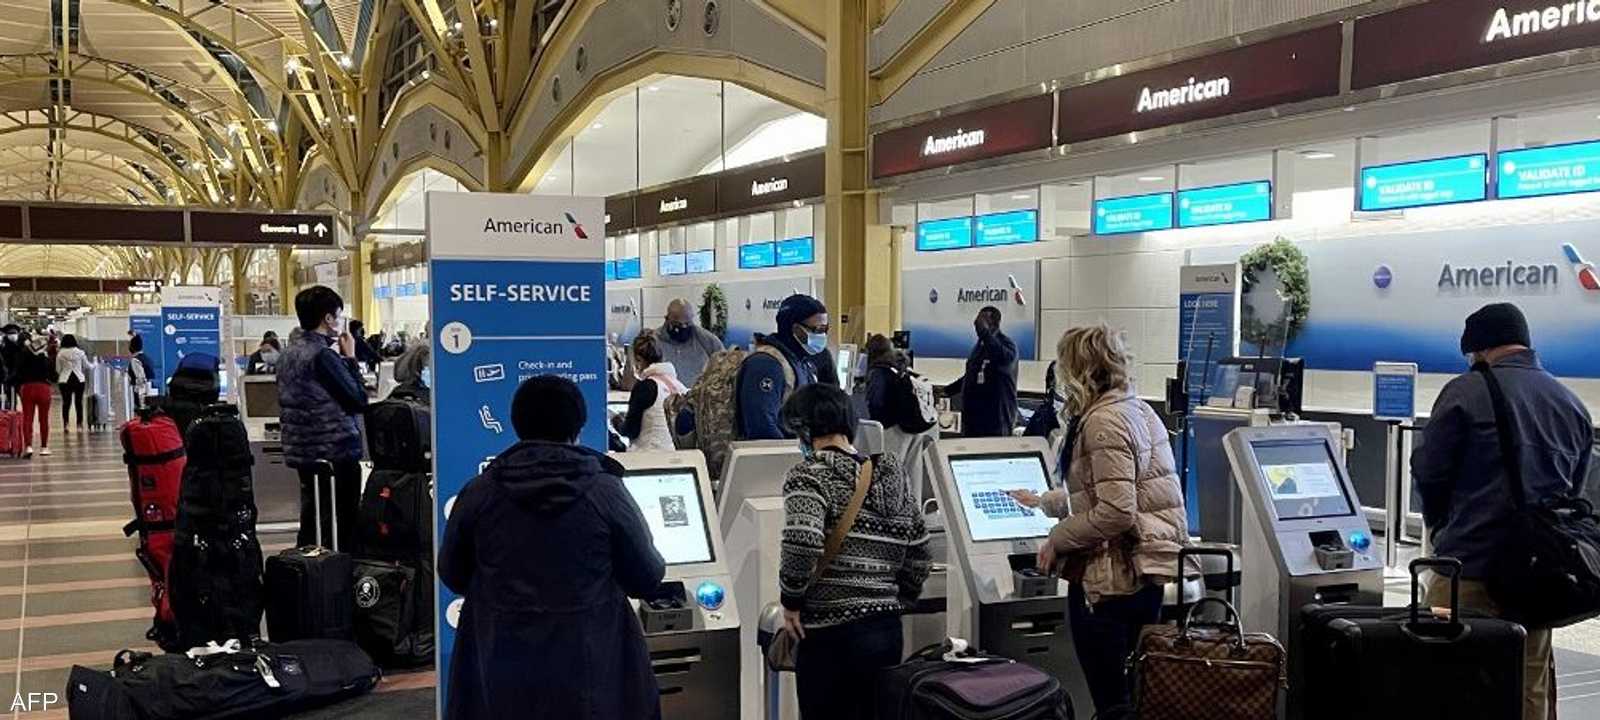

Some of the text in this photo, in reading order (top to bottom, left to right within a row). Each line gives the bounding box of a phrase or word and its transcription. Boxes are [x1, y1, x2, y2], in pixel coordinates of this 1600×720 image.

[1137, 77, 1230, 113] American
[924, 127, 985, 155] American
[751, 176, 788, 196] American
[484, 217, 564, 235] American
[1438, 260, 1558, 288] American
[450, 283, 592, 302] SELF-SERVICE
[957, 285, 1008, 303] American
[451, 334, 459, 349] 1
[518, 360, 573, 370] Check-in and
[579, 373, 598, 383] pass
